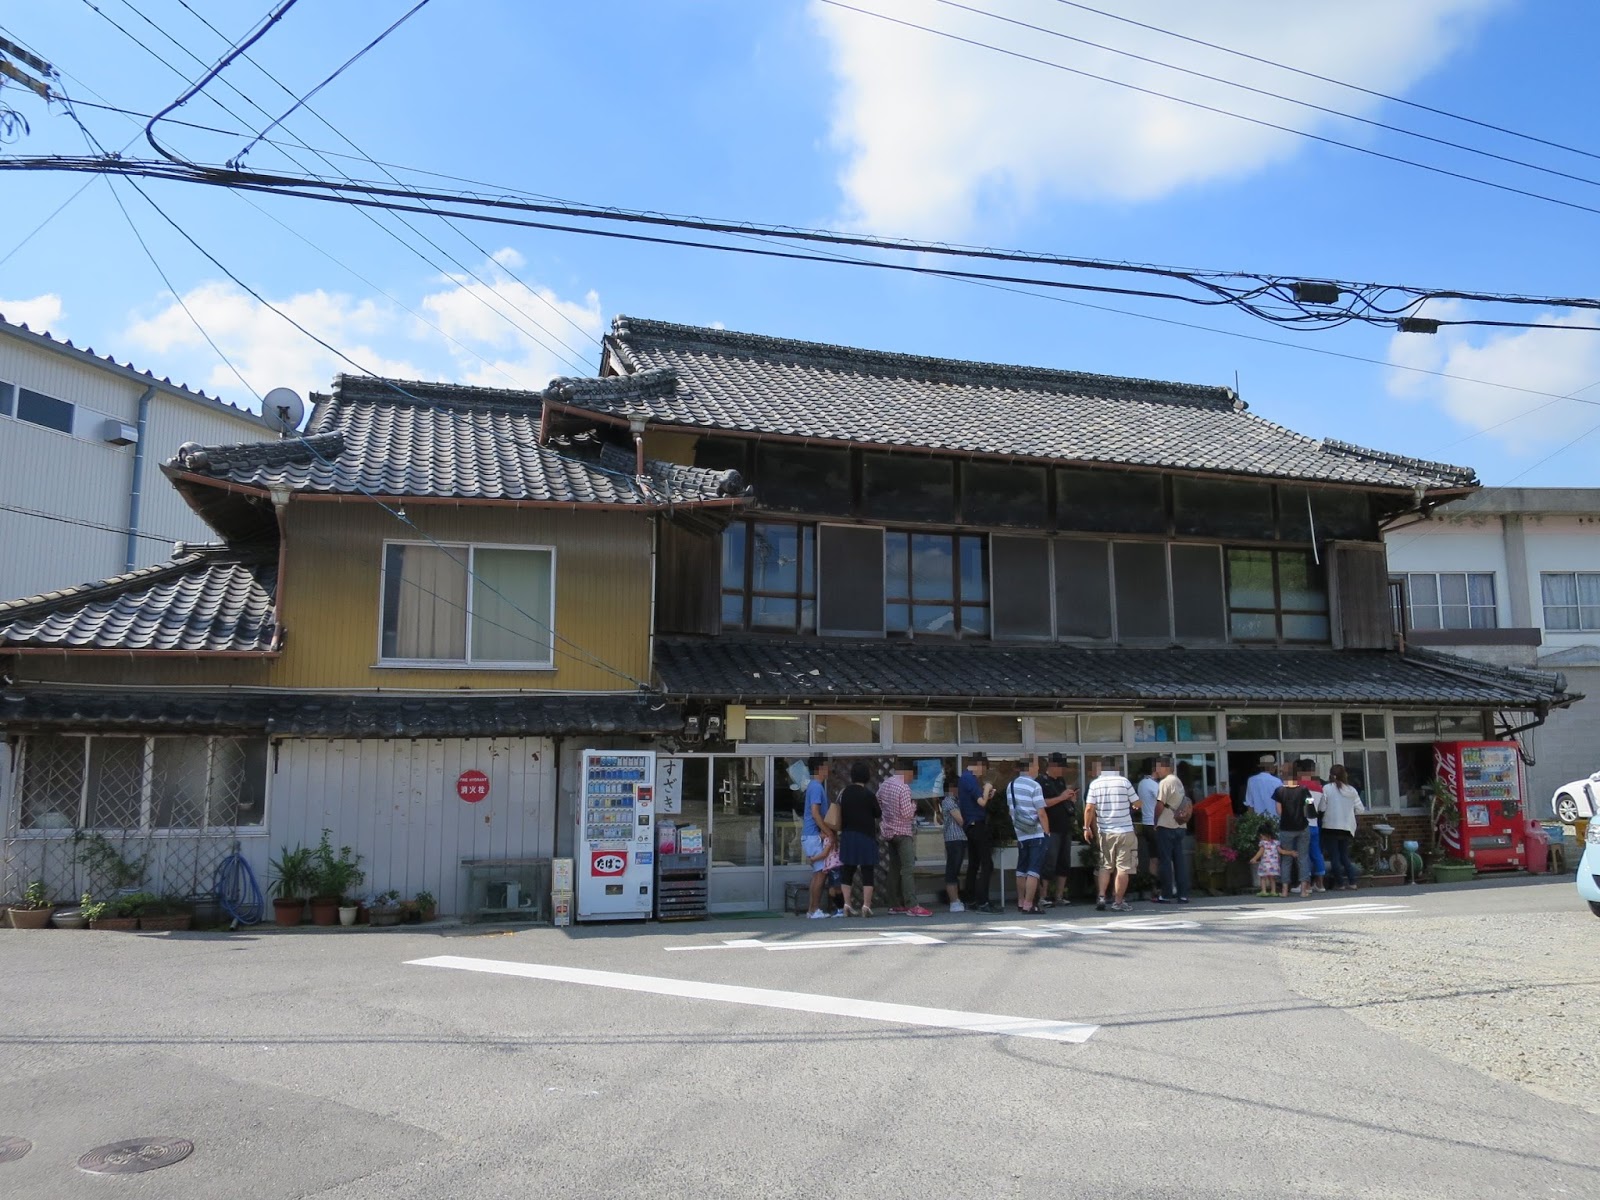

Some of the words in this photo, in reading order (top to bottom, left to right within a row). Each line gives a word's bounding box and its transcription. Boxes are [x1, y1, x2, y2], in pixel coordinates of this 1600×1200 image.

[460, 785, 485, 794] 消火栓
[663, 760, 677, 812] すざき
[1433, 747, 1460, 850] CoCola
[597, 858, 621, 869] たばこ
